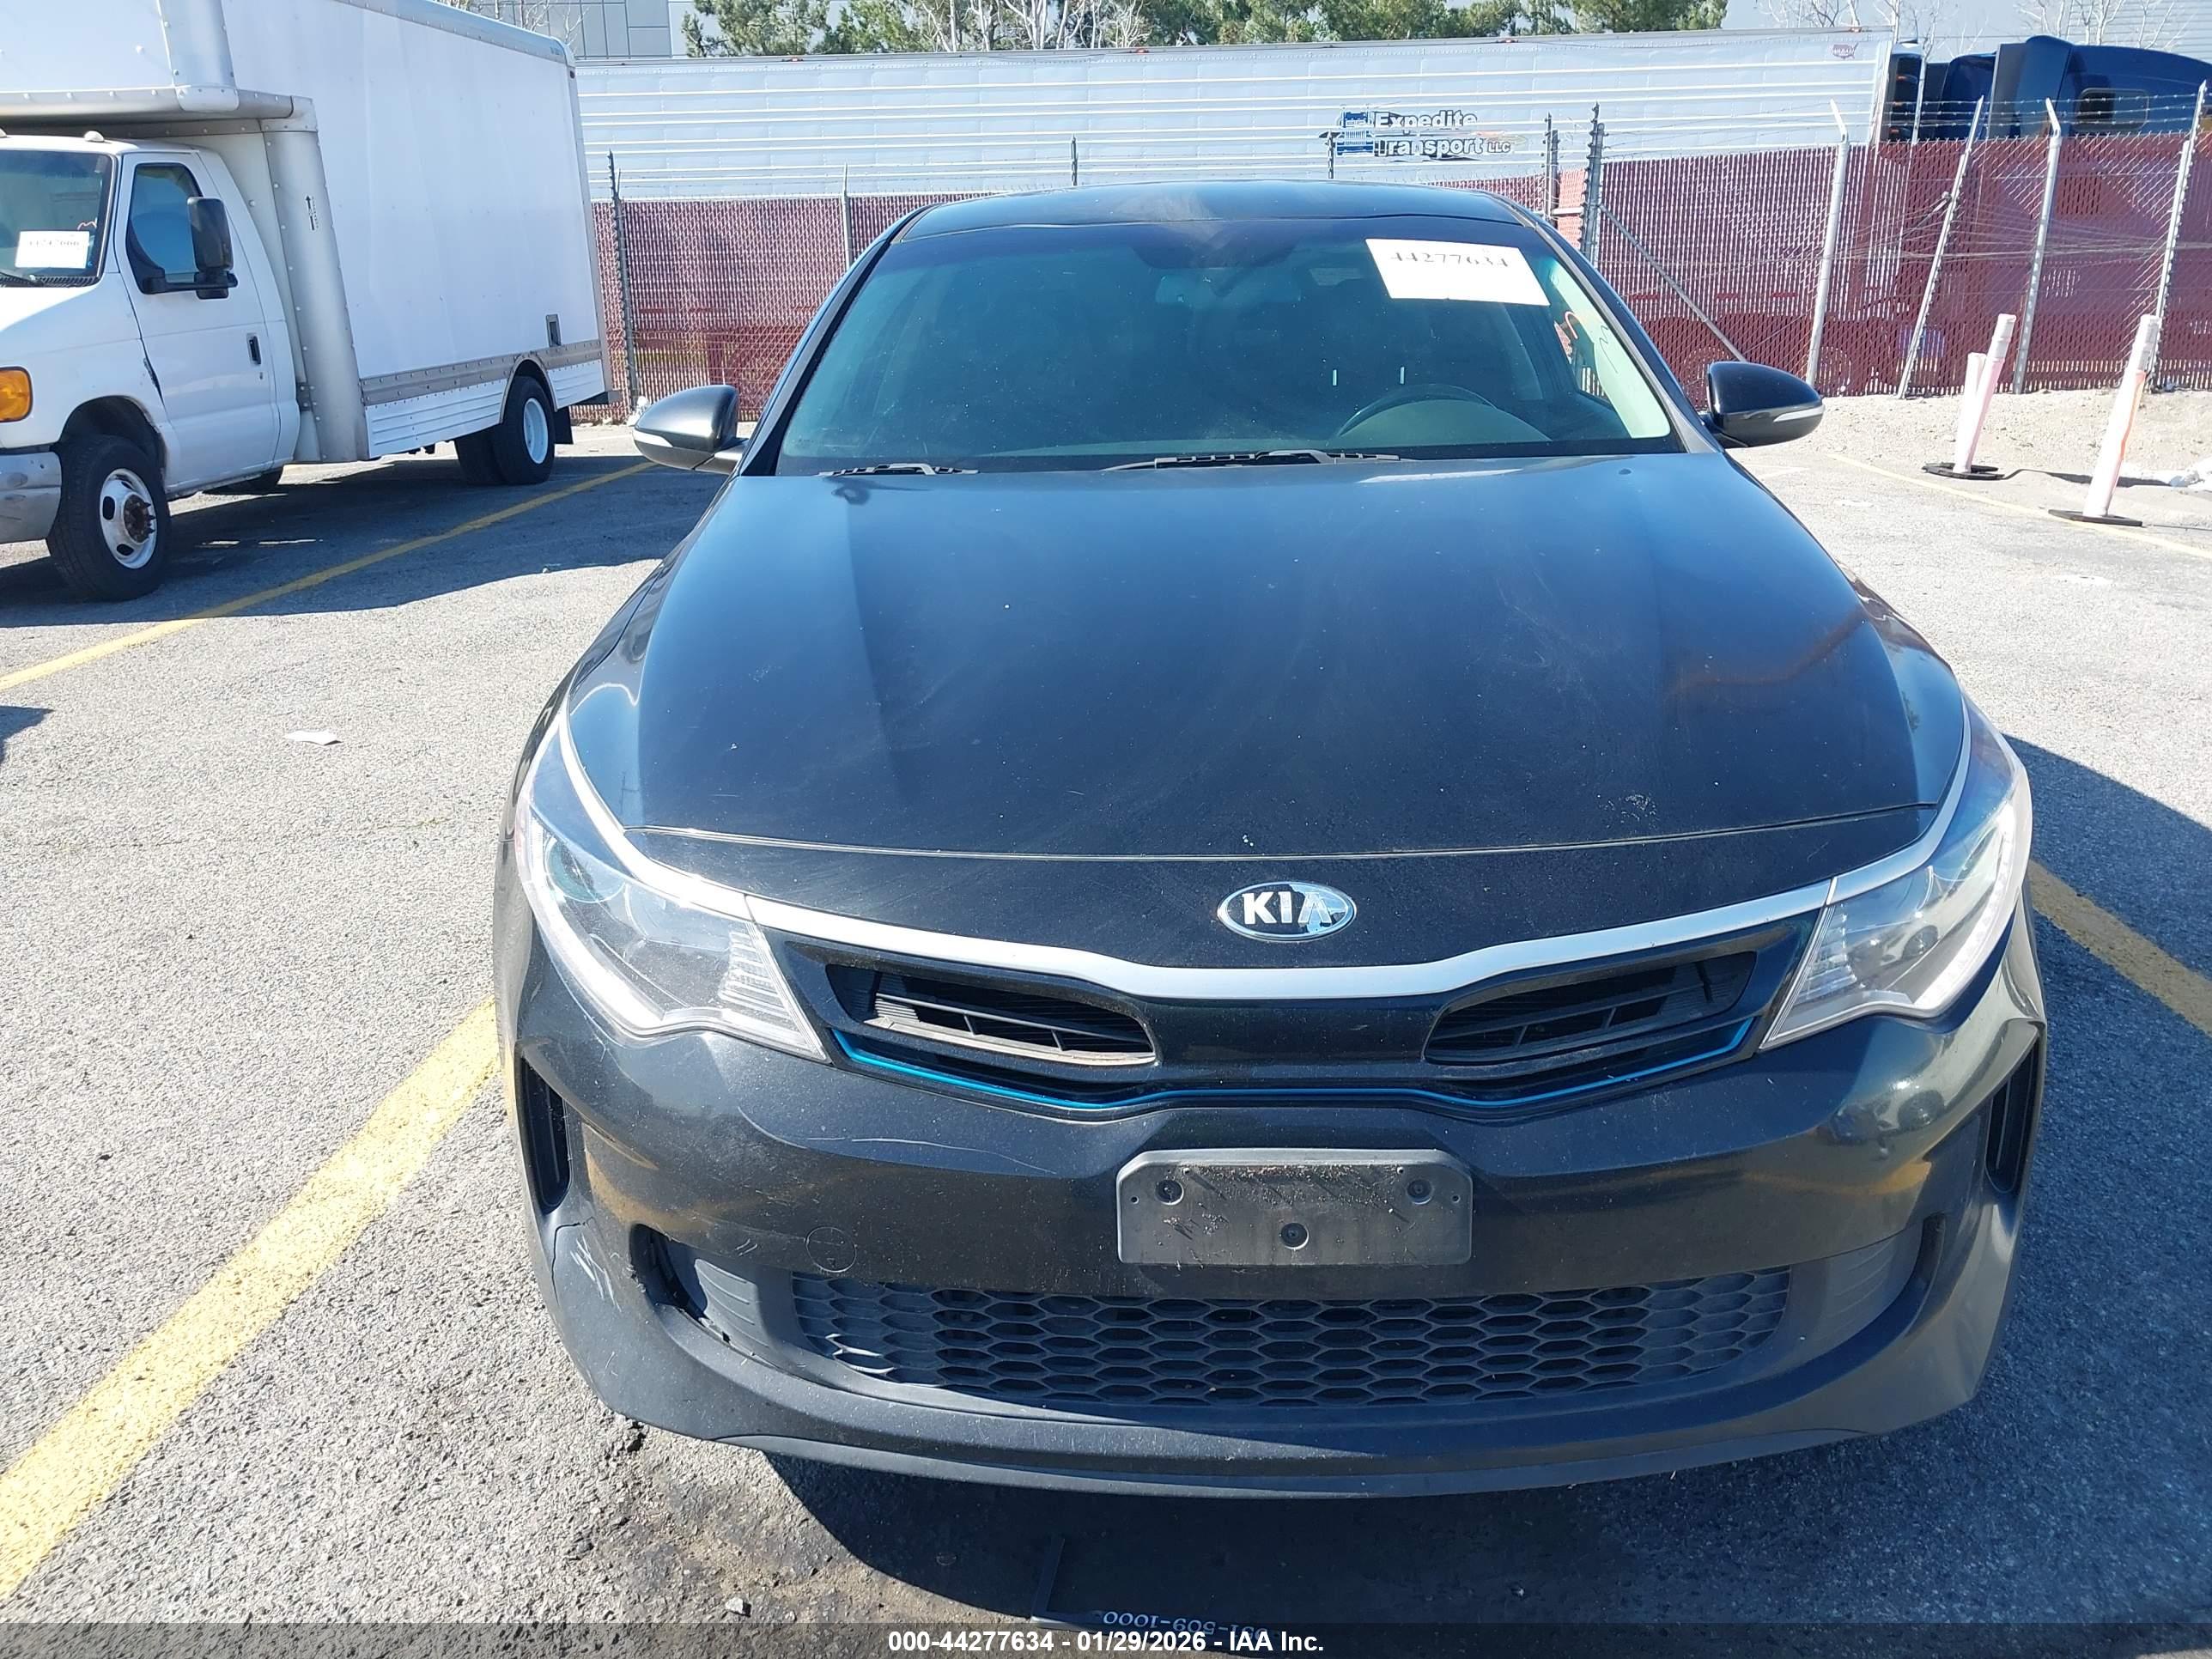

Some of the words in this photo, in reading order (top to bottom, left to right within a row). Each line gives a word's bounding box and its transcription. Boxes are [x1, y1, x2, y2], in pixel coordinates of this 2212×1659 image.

[1374, 110, 1478, 134] Expedite
[1374, 137, 1484, 160] Transport
[1486, 141, 1511, 153] LLC
[1390, 252, 1509, 268] 44277634
[1242, 890, 1333, 927] KIA
